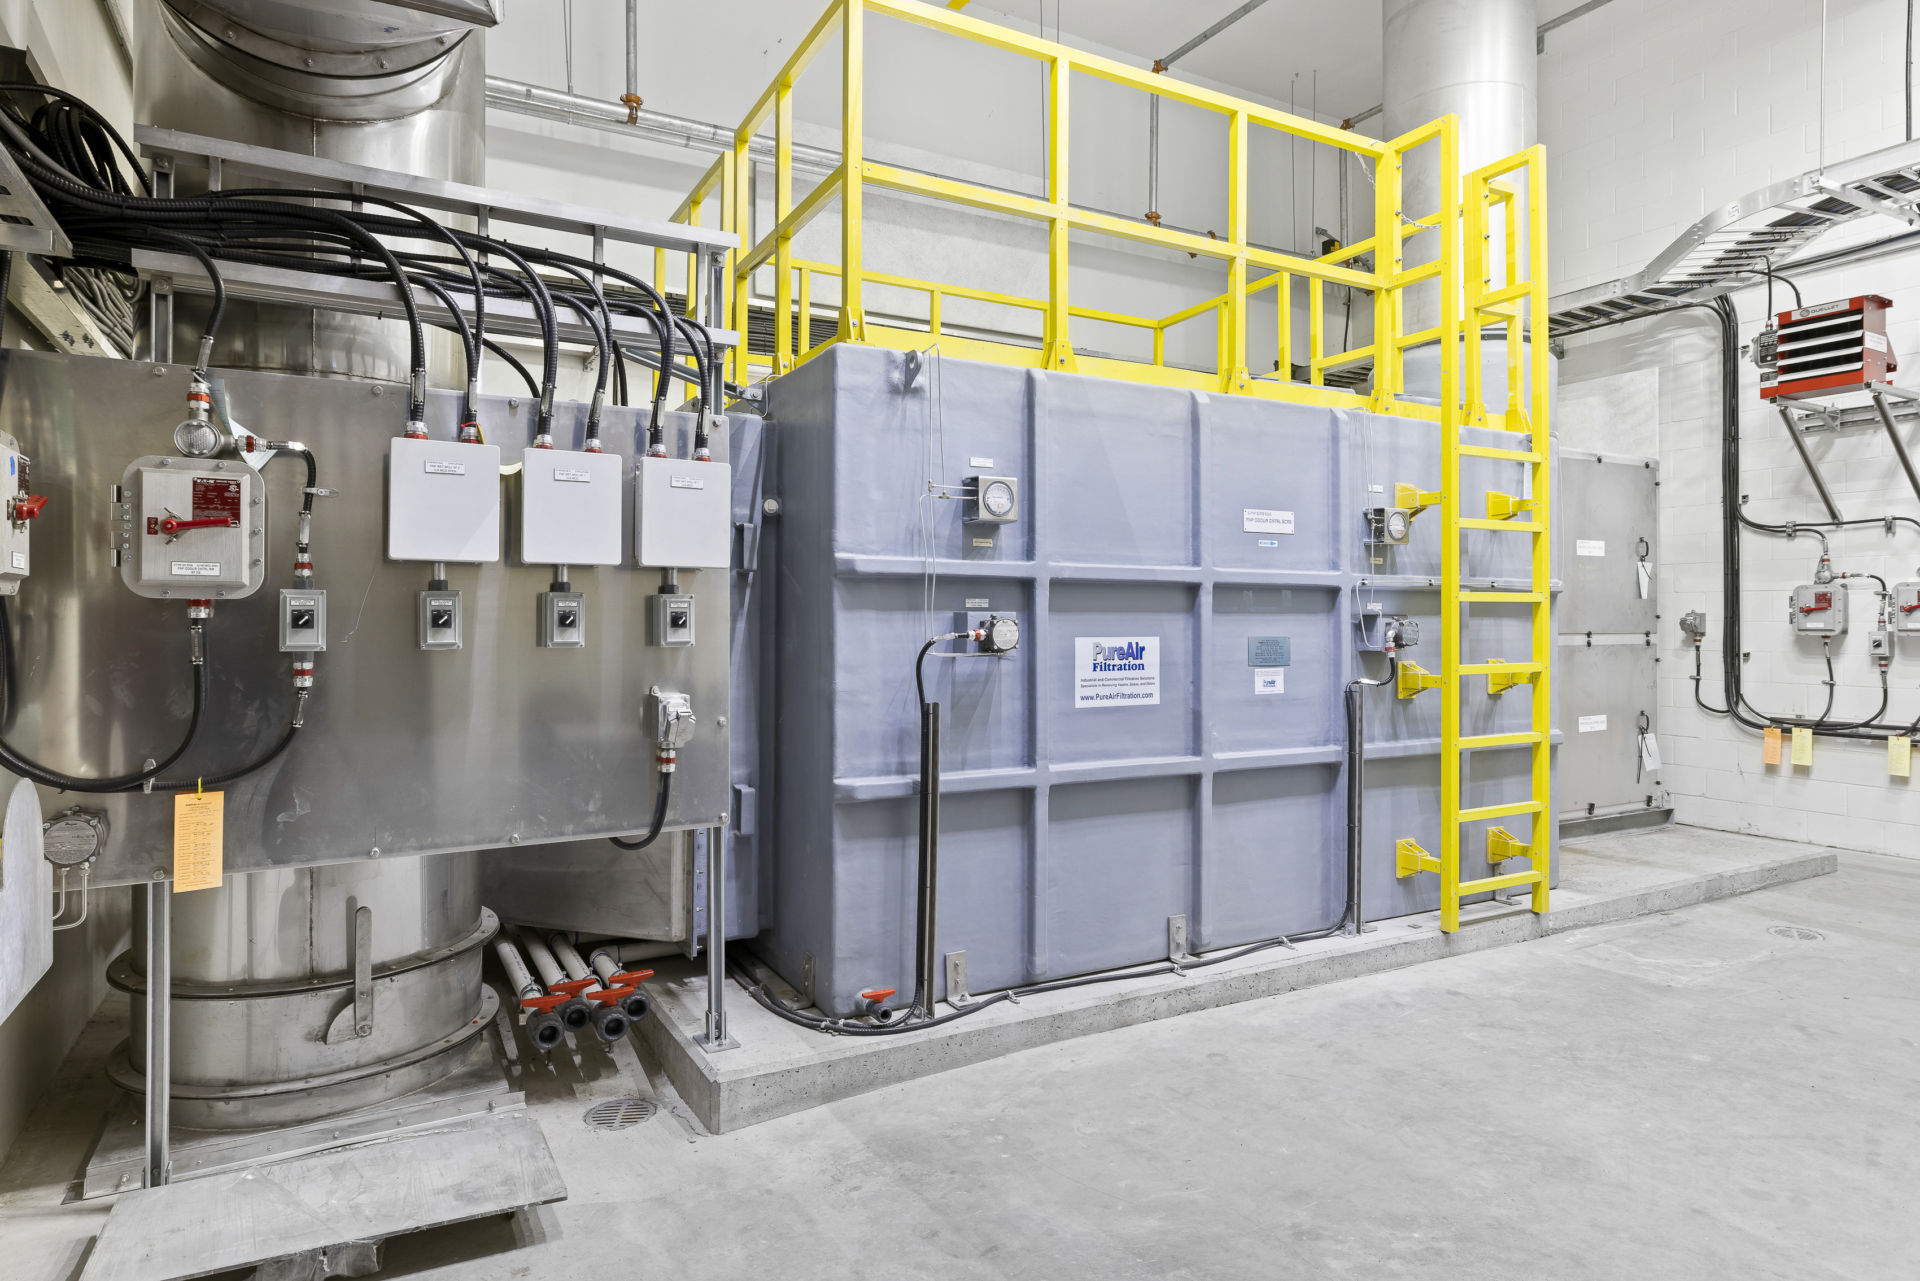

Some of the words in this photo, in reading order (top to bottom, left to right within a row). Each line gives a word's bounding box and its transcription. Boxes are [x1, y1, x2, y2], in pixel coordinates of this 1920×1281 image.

[1811, 304, 1839, 314] OUELLET
[1093, 641, 1146, 662] PureAir
[1092, 661, 1145, 672] Filtration
[1079, 692, 1154, 701] www.PureAirFiltration.com
